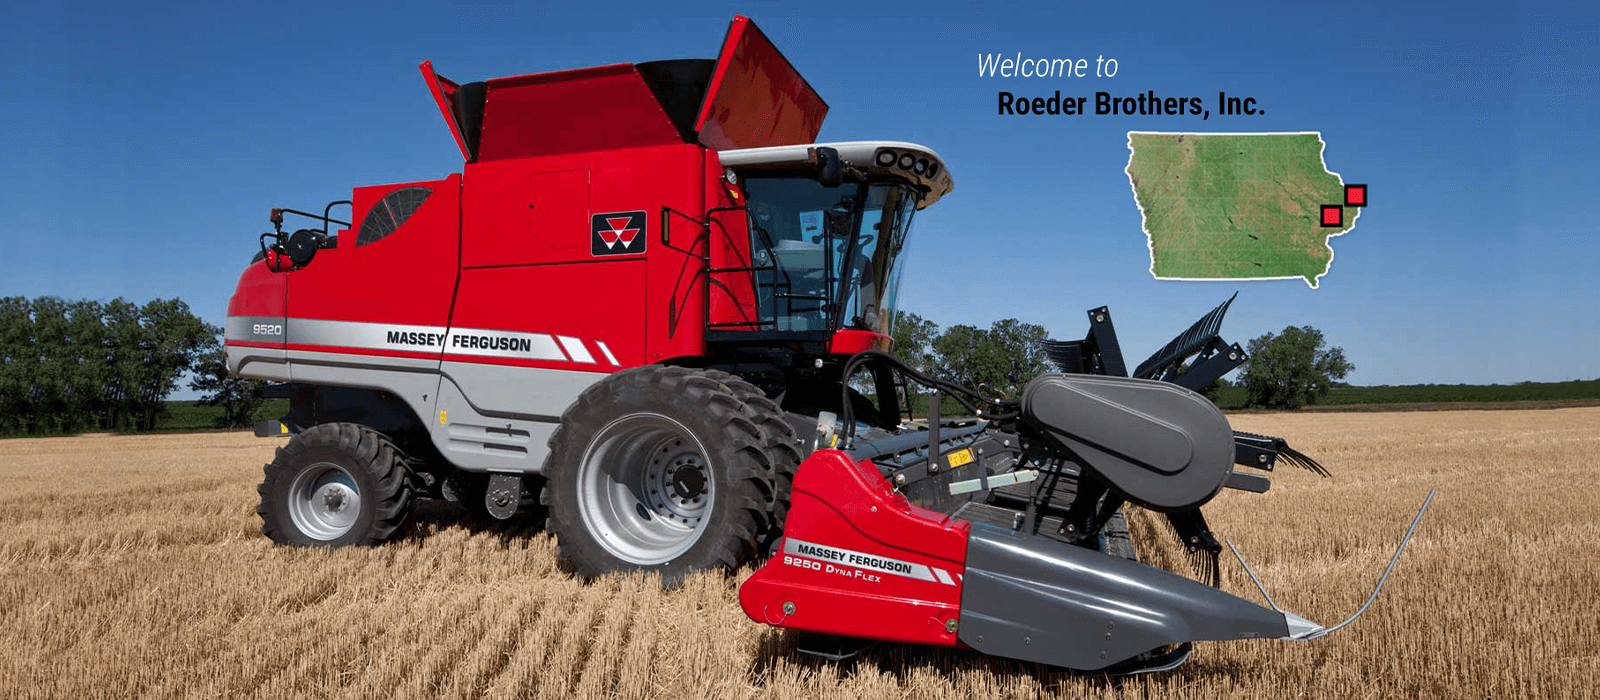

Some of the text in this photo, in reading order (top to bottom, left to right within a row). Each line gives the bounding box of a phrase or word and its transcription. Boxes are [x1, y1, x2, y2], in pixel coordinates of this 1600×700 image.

[252, 324, 282, 336] 9520
[386, 330, 531, 352] MASSEY FERGUSON
[783, 556, 821, 571] 9250
[798, 543, 912, 574] MASSEY FERGUSON
